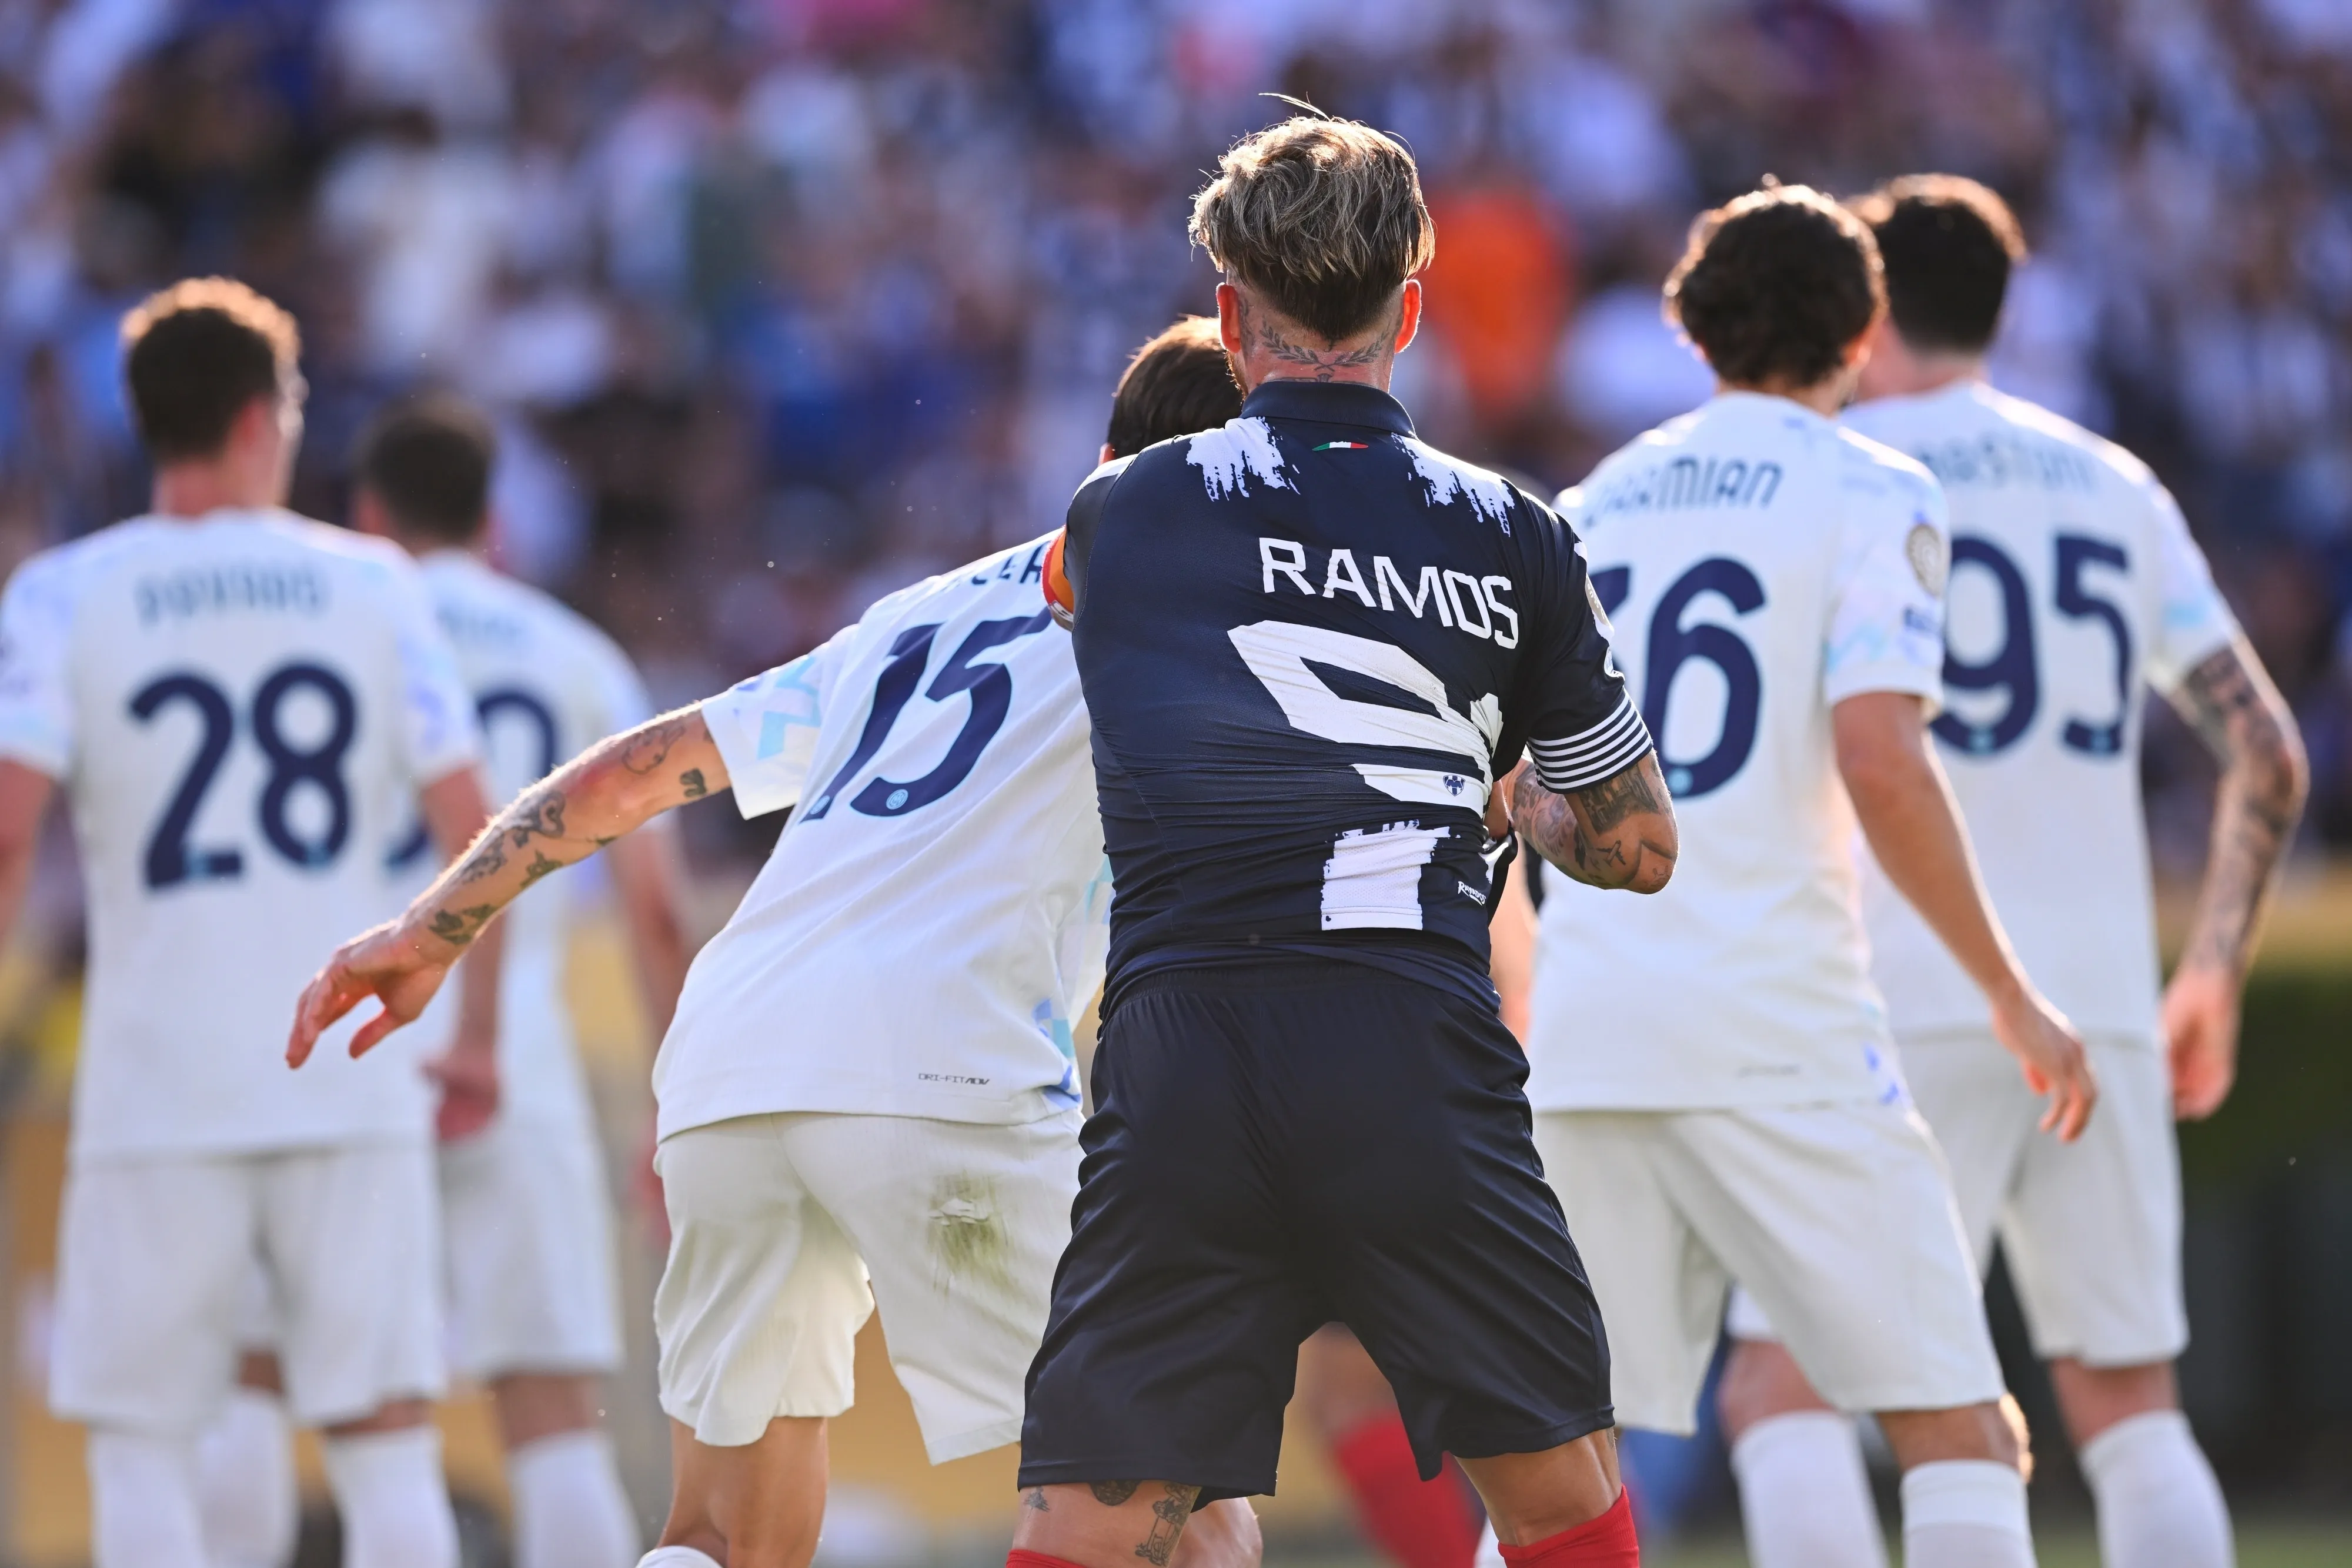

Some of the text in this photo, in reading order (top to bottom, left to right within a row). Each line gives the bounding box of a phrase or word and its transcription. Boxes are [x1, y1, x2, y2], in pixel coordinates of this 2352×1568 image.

[1259, 537, 1518, 649] RAMOS
[1929, 533, 2130, 755] 95
[128, 662, 358, 889] 28
[799, 608, 1051, 824] 15
[1458, 881, 1486, 906] RAYADOS
